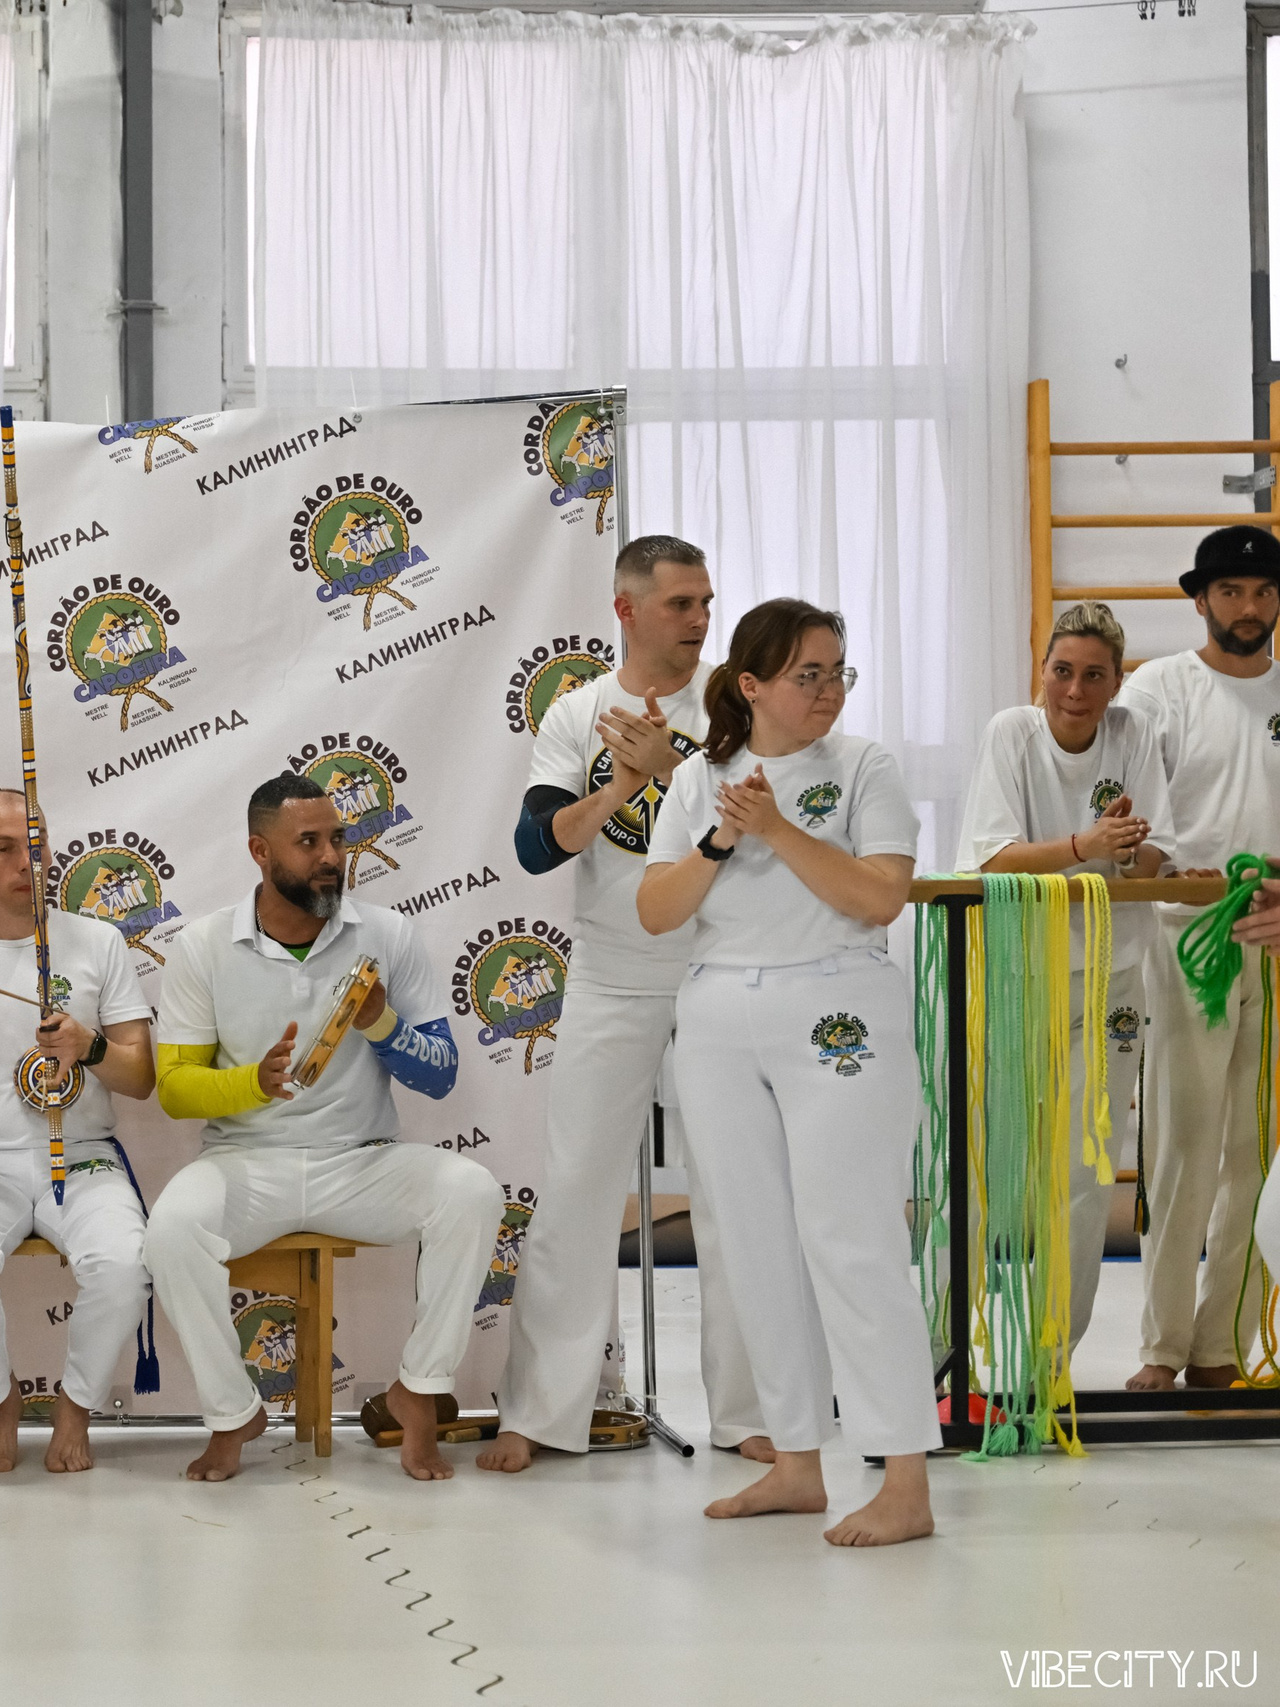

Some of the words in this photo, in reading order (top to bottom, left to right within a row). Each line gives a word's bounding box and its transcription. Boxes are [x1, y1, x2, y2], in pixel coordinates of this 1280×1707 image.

[195, 415, 357, 496] КАЛИНИНГРАД
[290, 485, 332, 572] CORDÃO
[336, 473, 365, 492] DE
[371, 476, 422, 525] OURO
[316, 545, 429, 603] CAPOEIRA
[47, 586, 89, 671] CORDÃO
[93, 574, 122, 593] DE
[128, 577, 180, 625] OURO
[335, 604, 496, 684] КАЛИНИНГРАД
[74, 646, 187, 702] CAPOEIRA
[506, 646, 549, 733] CORDÃO
[552, 635, 580, 654] DE
[86, 708, 248, 788] КАЛИНИНГРАД
[322, 732, 350, 751] DE
[357, 736, 407, 783] OURO
[344, 804, 413, 843] OEIRA
[604, 819, 637, 846] RUPO
[88, 829, 116, 848] DE
[123, 832, 175, 880] OURO
[452, 929, 494, 1016] CORDÃO
[498, 918, 526, 936] DE
[852, 1016, 868, 1037] OURO
[18, 1377, 47, 1396] DE
